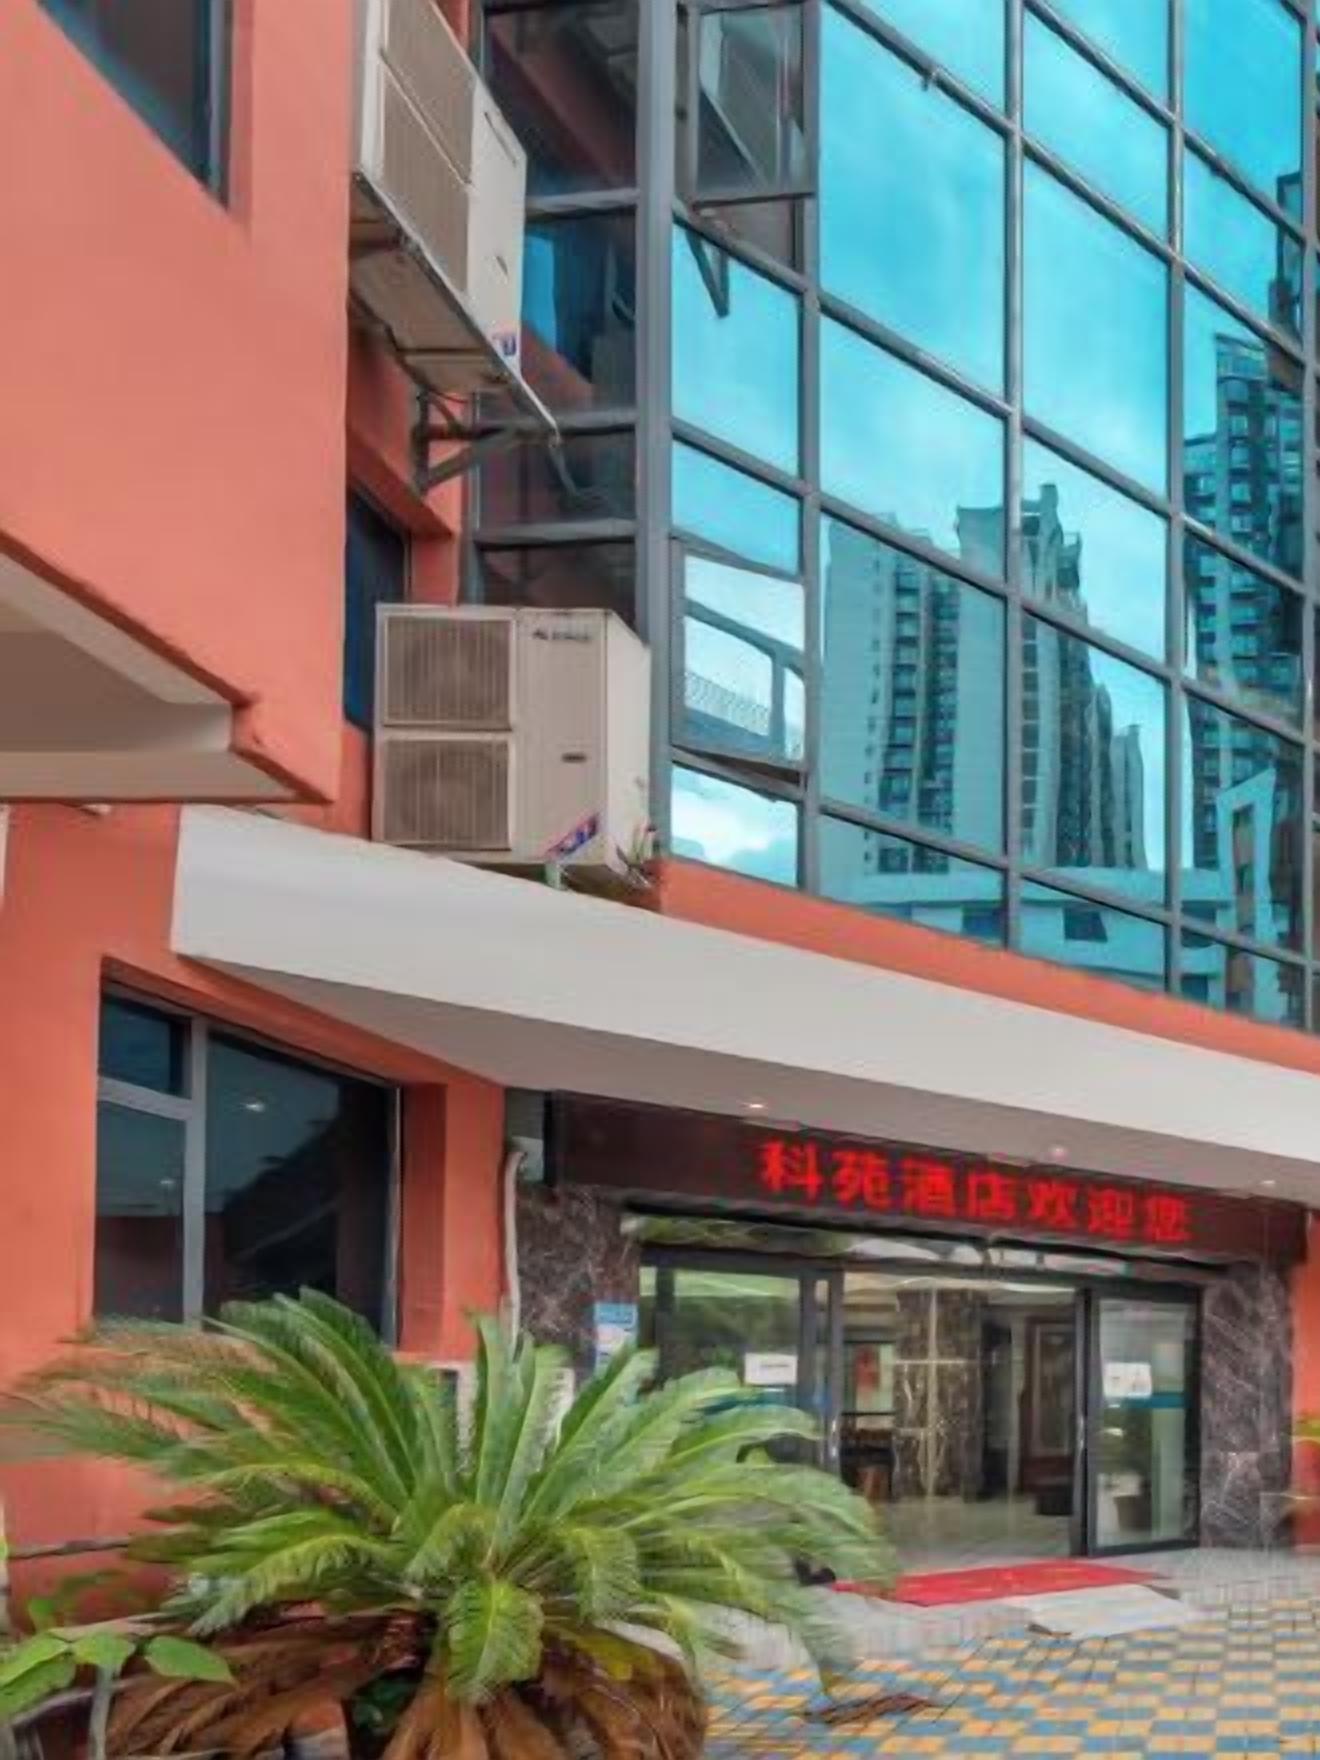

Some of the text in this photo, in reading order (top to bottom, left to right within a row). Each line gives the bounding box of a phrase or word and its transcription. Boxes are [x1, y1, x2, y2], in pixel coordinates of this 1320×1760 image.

[760, 1140, 1190, 1242] 科苑酒店欢迎您
